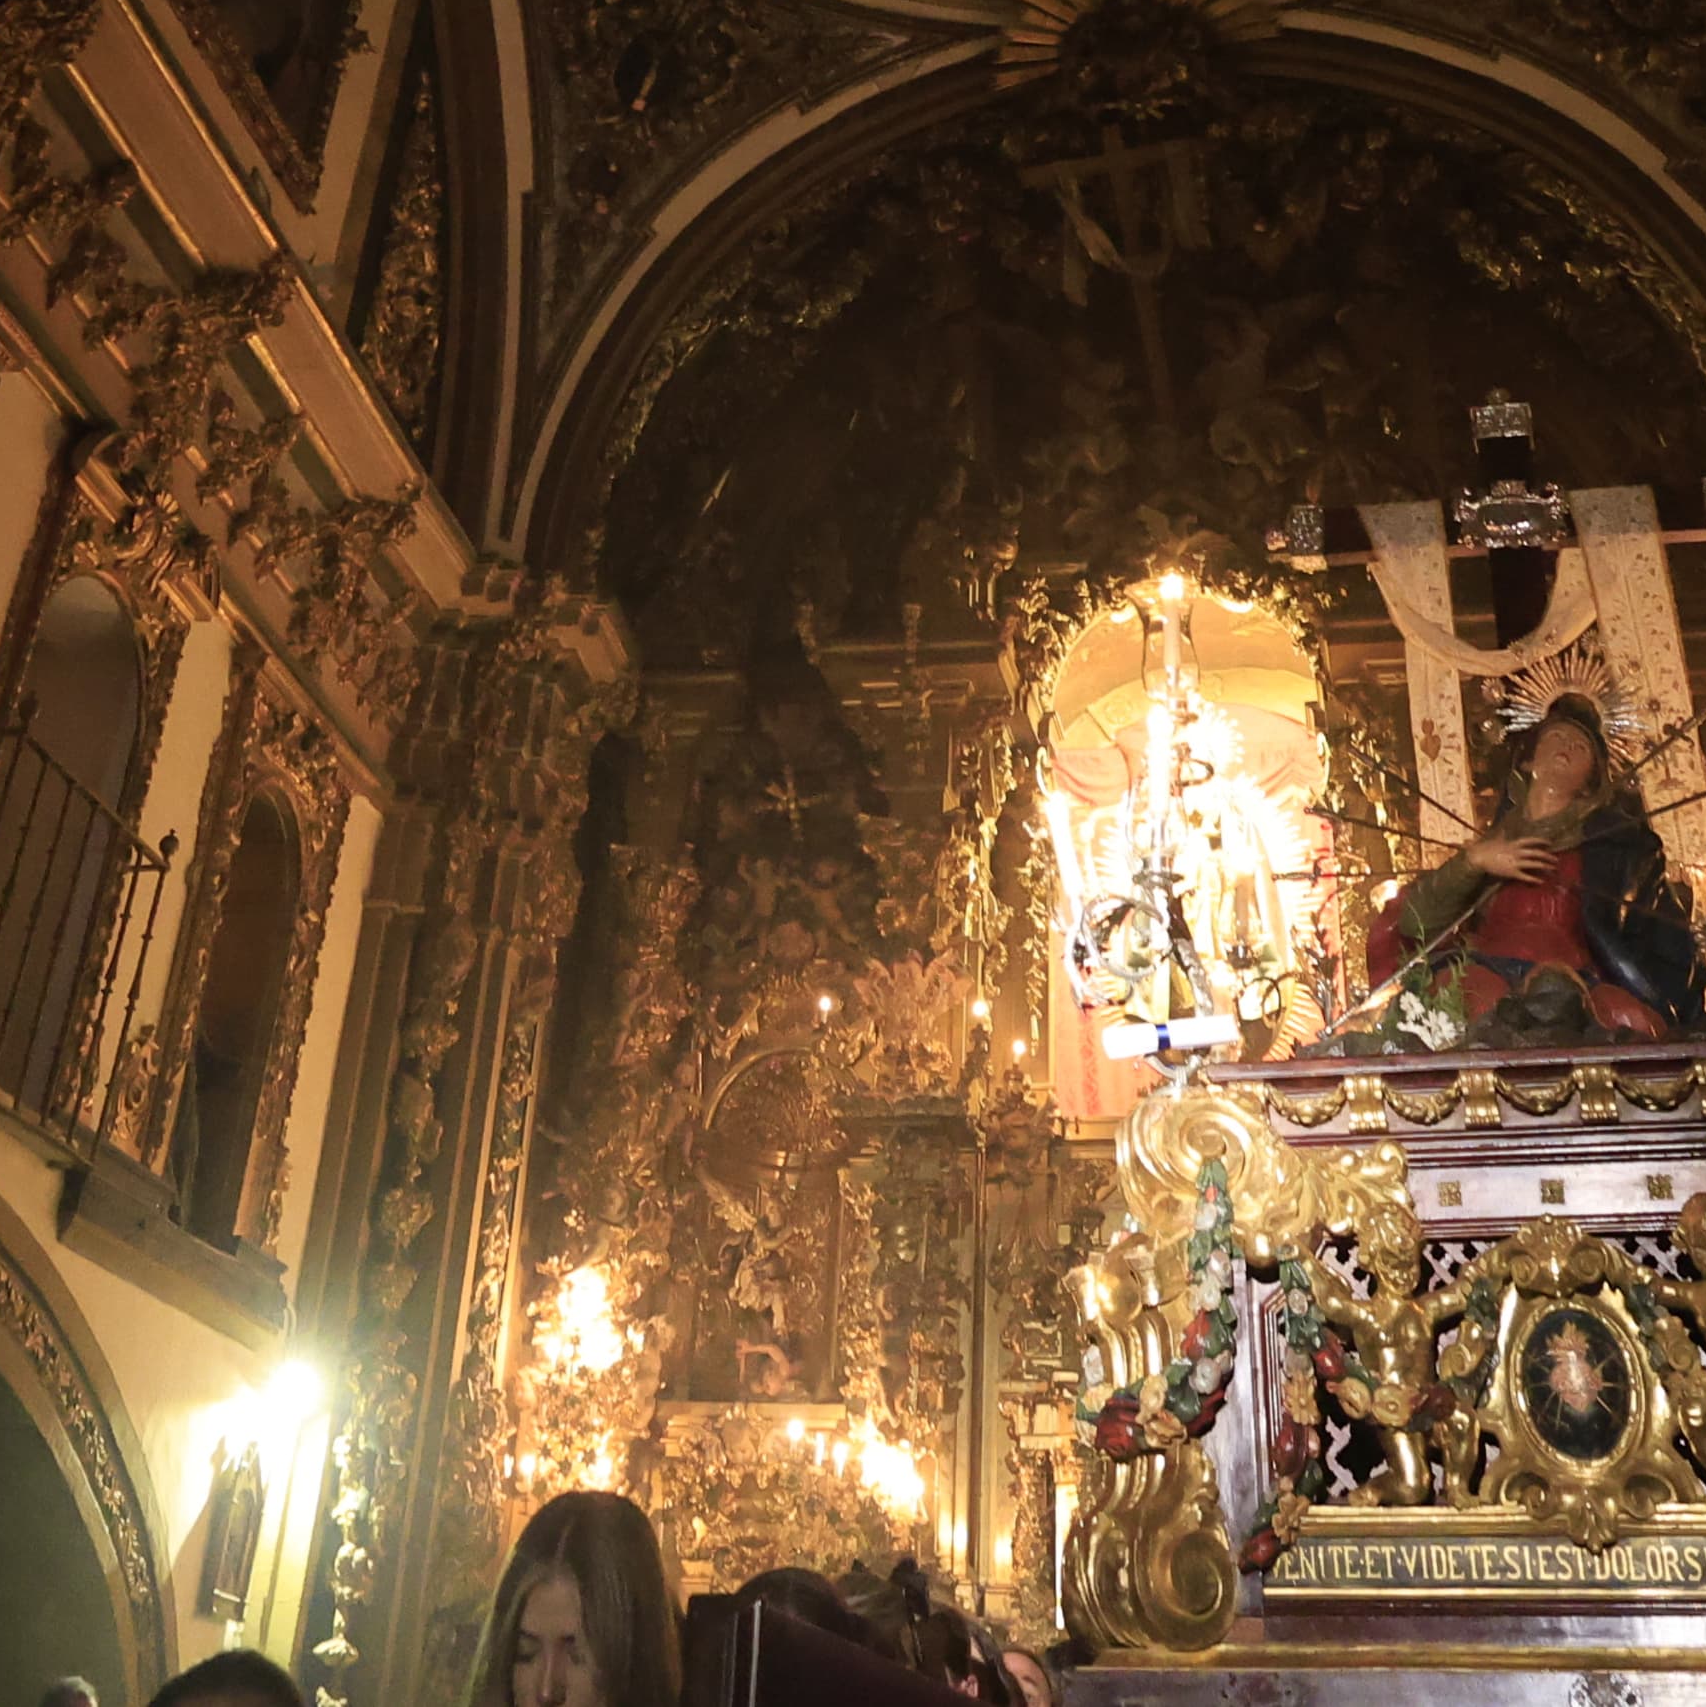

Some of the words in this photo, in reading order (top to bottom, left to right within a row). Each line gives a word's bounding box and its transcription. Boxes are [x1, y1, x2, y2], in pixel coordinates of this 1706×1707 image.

[1364, 1545, 1395, 1578] ET
[1400, 1545, 1500, 1580] VIDETE
[1503, 1545, 1532, 1580] SI
[1536, 1545, 1586, 1581] EST
[1593, 1545, 1684, 1581] DOLOR
